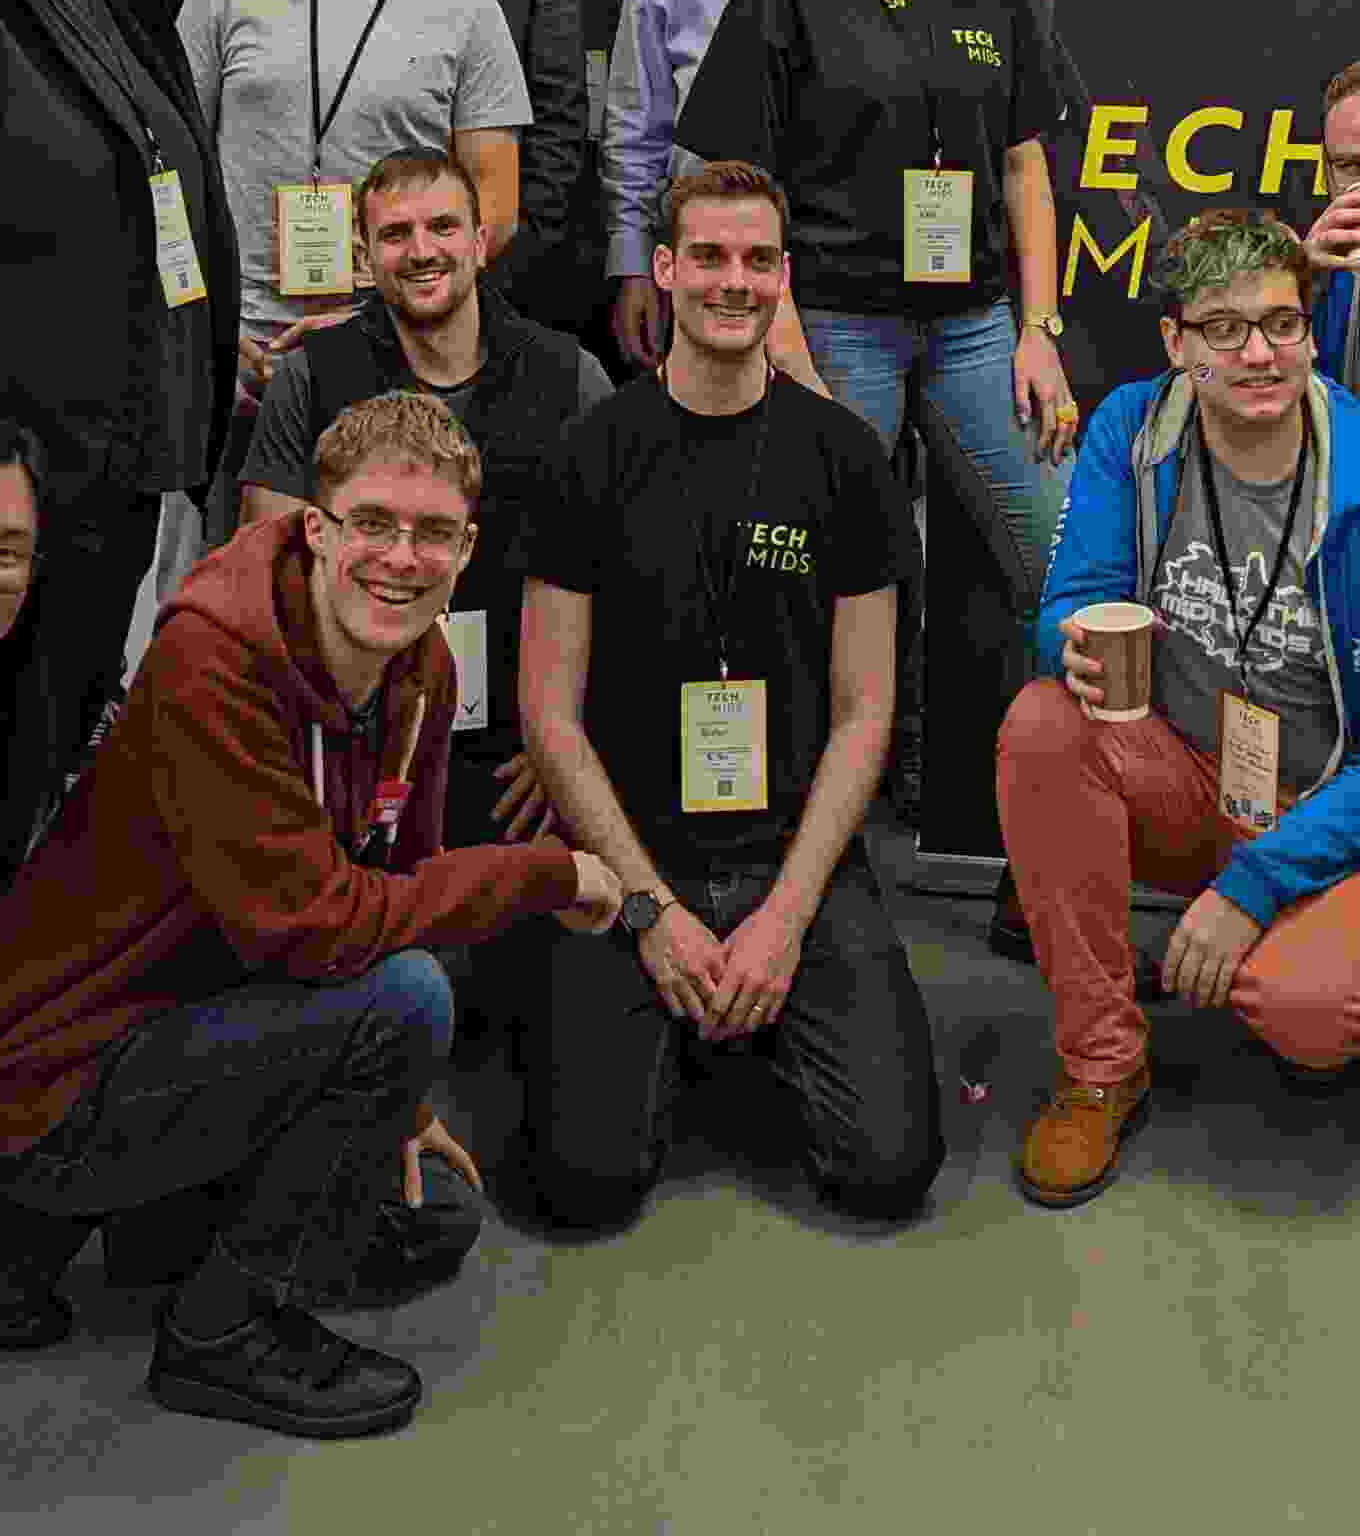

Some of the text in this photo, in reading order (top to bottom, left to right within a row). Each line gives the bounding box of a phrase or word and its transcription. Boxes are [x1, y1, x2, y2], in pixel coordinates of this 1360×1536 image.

[952, 29, 994, 49] TECH
[968, 45, 1002, 67] MIDS
[1080, 105, 1328, 194] ECH
[745, 547, 812, 576] MIDS
